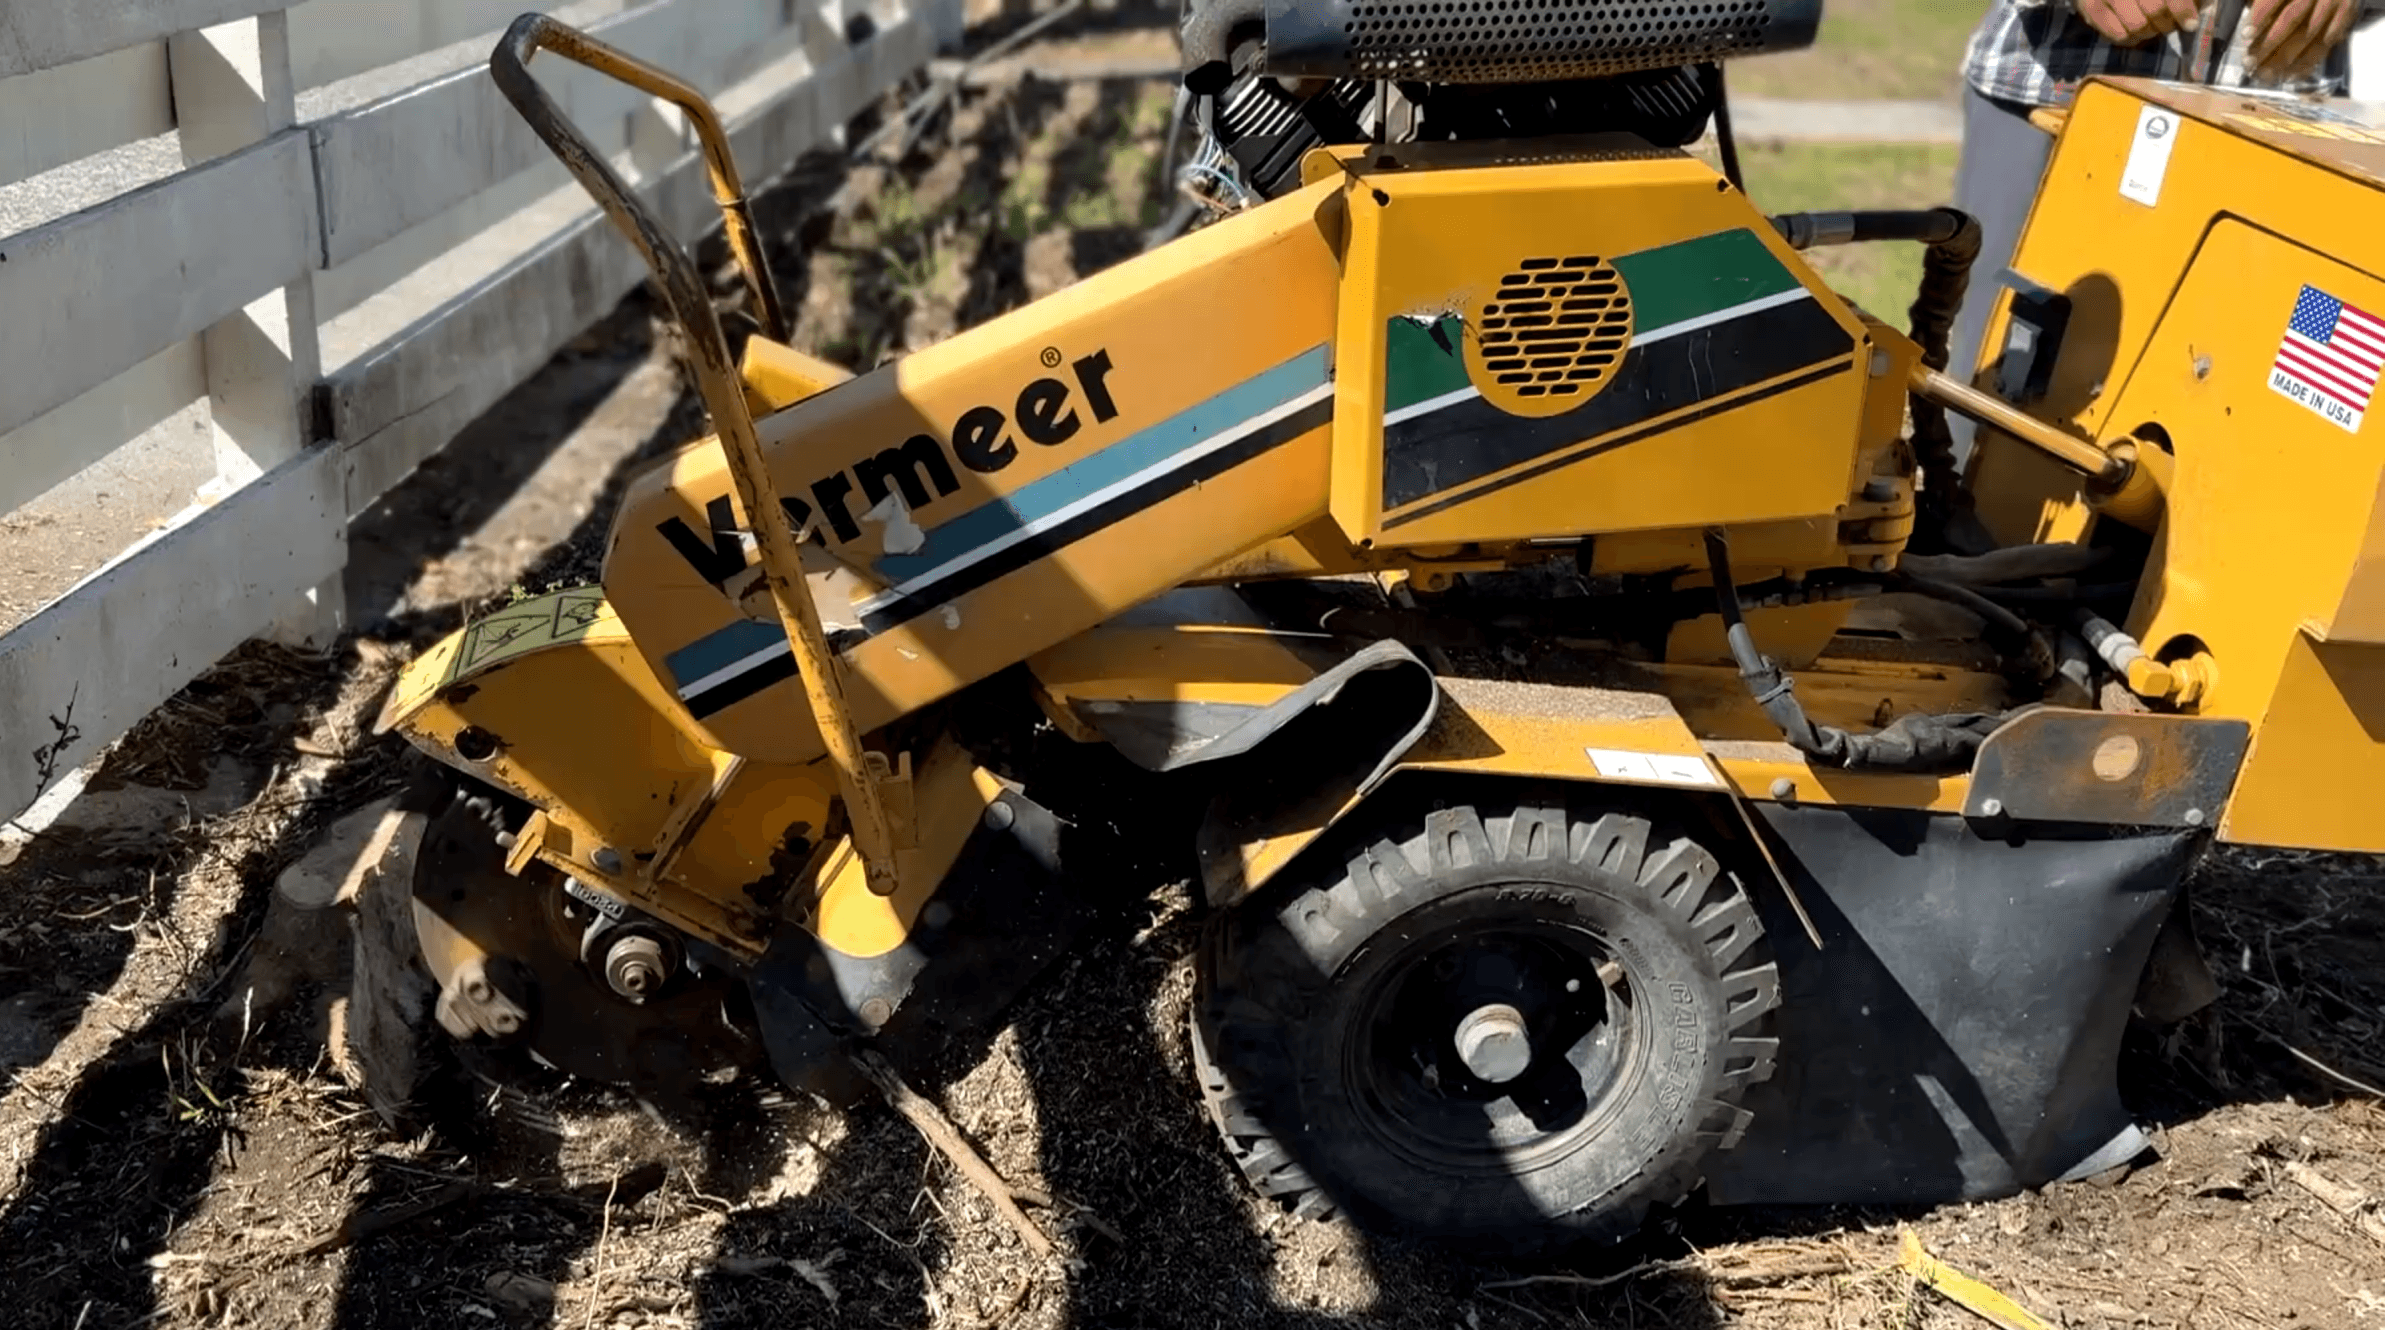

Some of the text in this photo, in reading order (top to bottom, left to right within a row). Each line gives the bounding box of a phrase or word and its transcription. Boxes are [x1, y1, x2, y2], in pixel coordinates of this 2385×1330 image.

[2273, 373, 2352, 426] MADE IN USA
